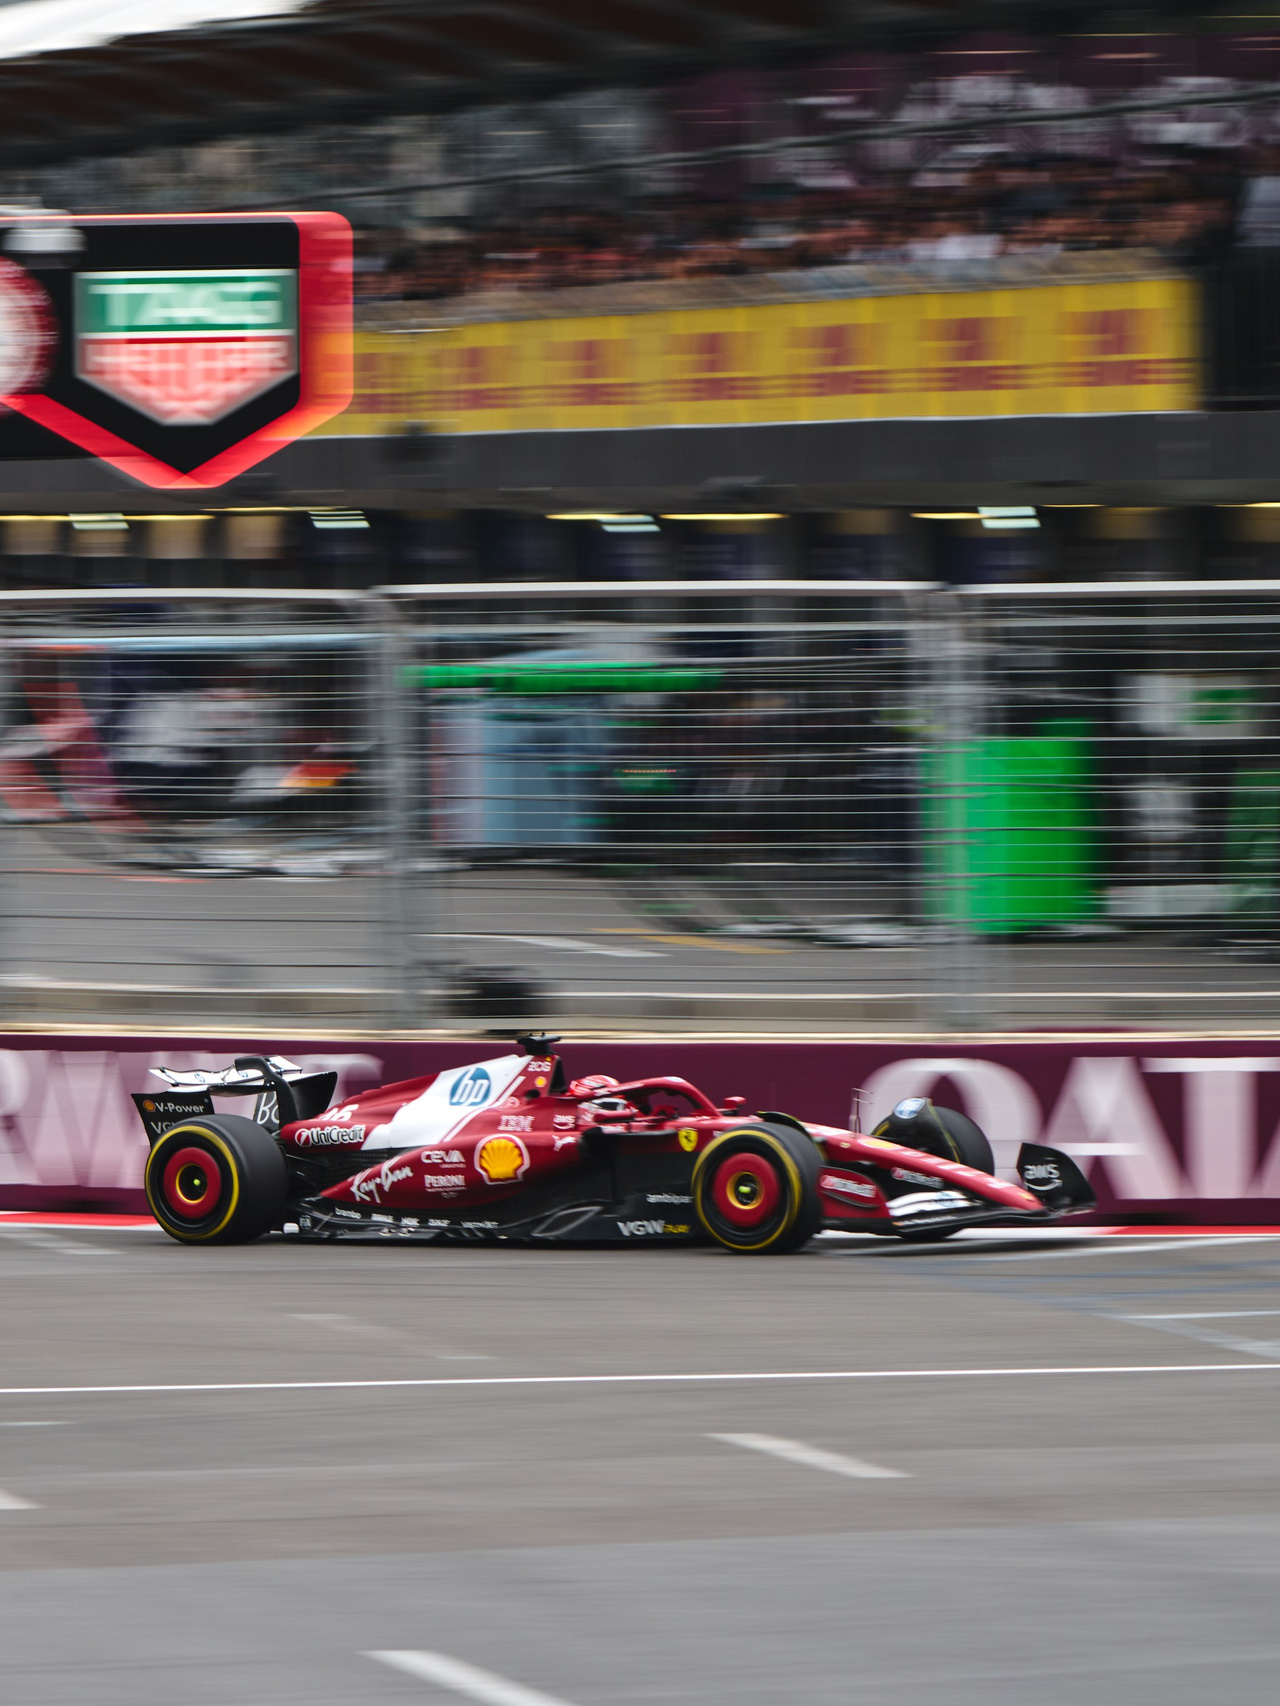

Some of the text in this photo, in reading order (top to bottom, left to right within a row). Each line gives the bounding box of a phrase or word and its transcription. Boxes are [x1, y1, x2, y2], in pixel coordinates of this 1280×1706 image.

[155, 1102, 204, 1113] V-Power
[497, 1115, 535, 1132] IBM
[310, 1125, 366, 1145] UniCredit
[1024, 1163, 1060, 1180] aws
[424, 1174, 466, 1188] PERONI
[617, 1220, 665, 1236] VGW
